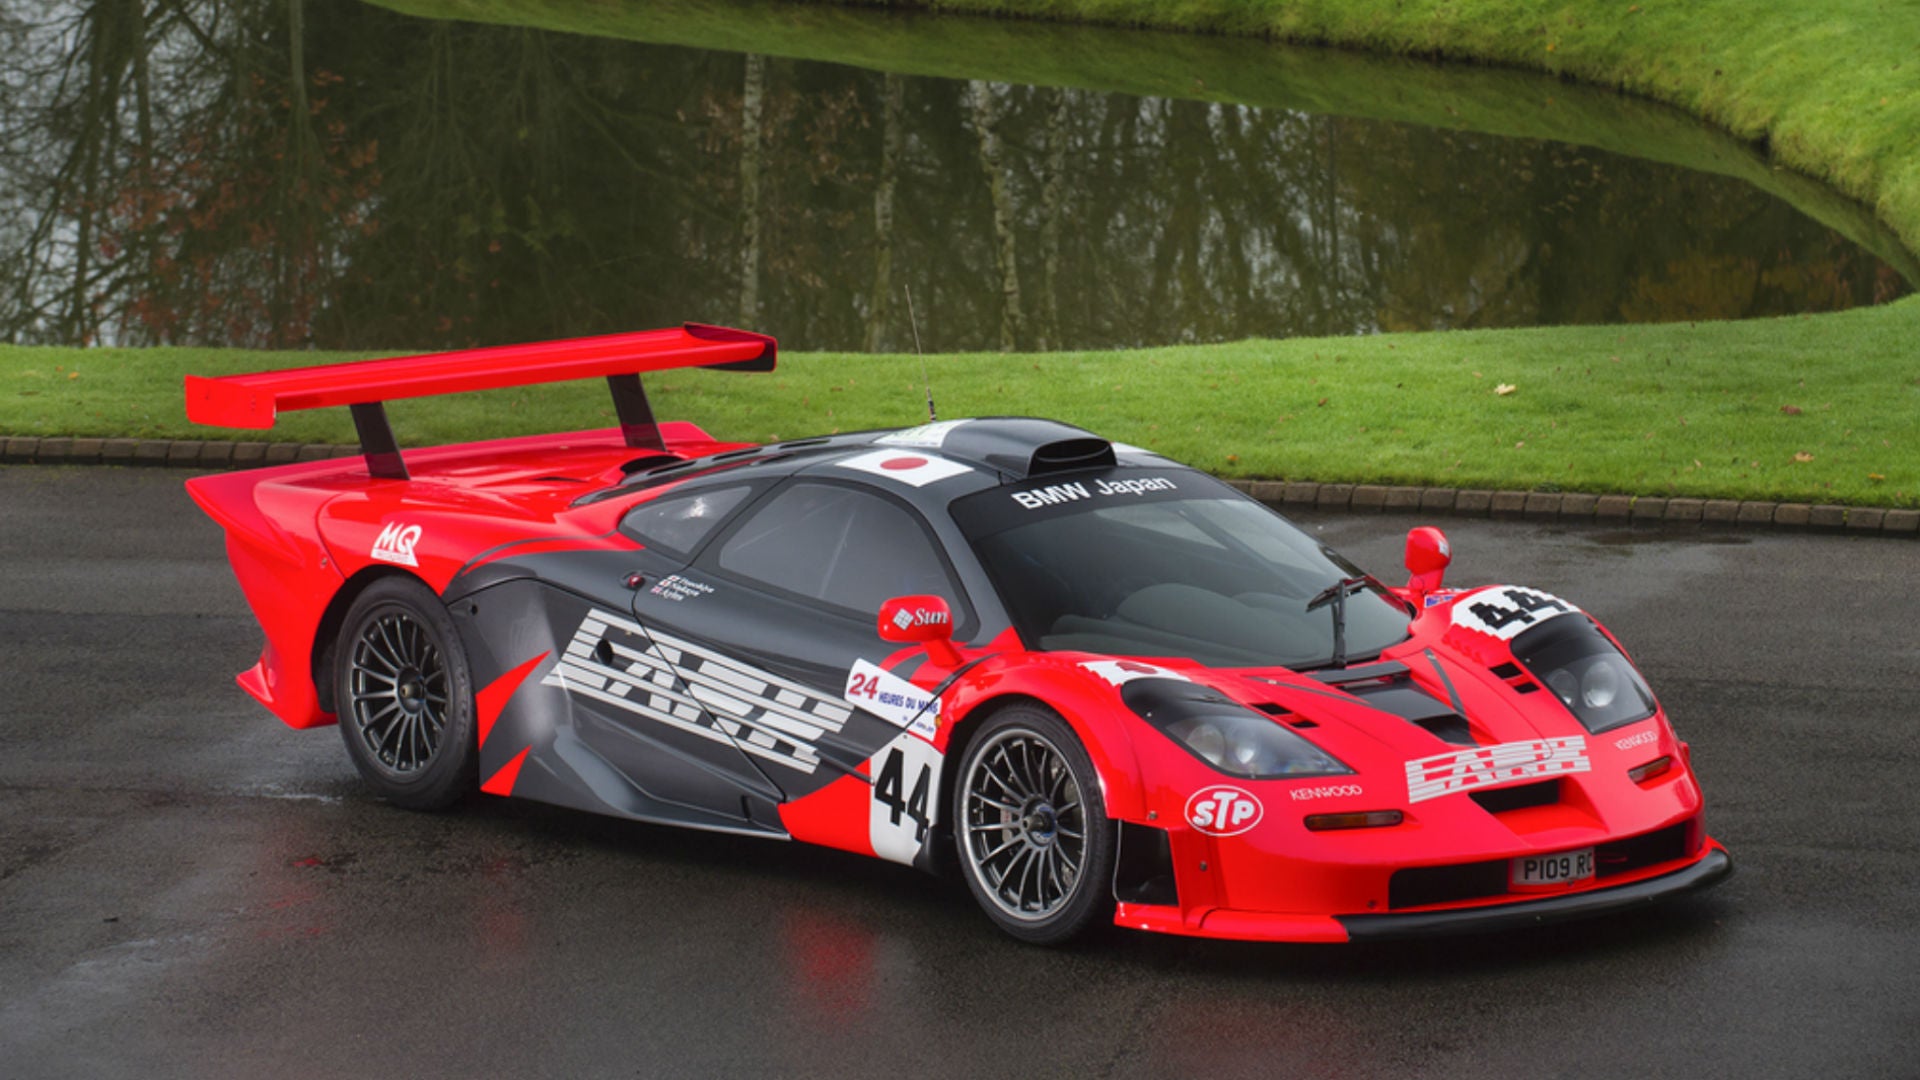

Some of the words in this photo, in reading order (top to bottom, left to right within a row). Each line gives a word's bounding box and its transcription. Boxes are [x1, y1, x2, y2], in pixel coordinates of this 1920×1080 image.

[1011, 481, 1091, 510] BMW
[1097, 475, 1178, 497] Japan
[371, 521, 423, 564] MQ
[914, 607, 949, 627] Sun
[1468, 590, 1568, 630] 44
[847, 673, 880, 700] 24
[905, 696, 917, 710] DU
[875, 747, 932, 844] 44
[1192, 791, 1255, 830] STP
[1290, 784, 1363, 801] KENWOOD
[1524, 857, 1571, 881] P109
